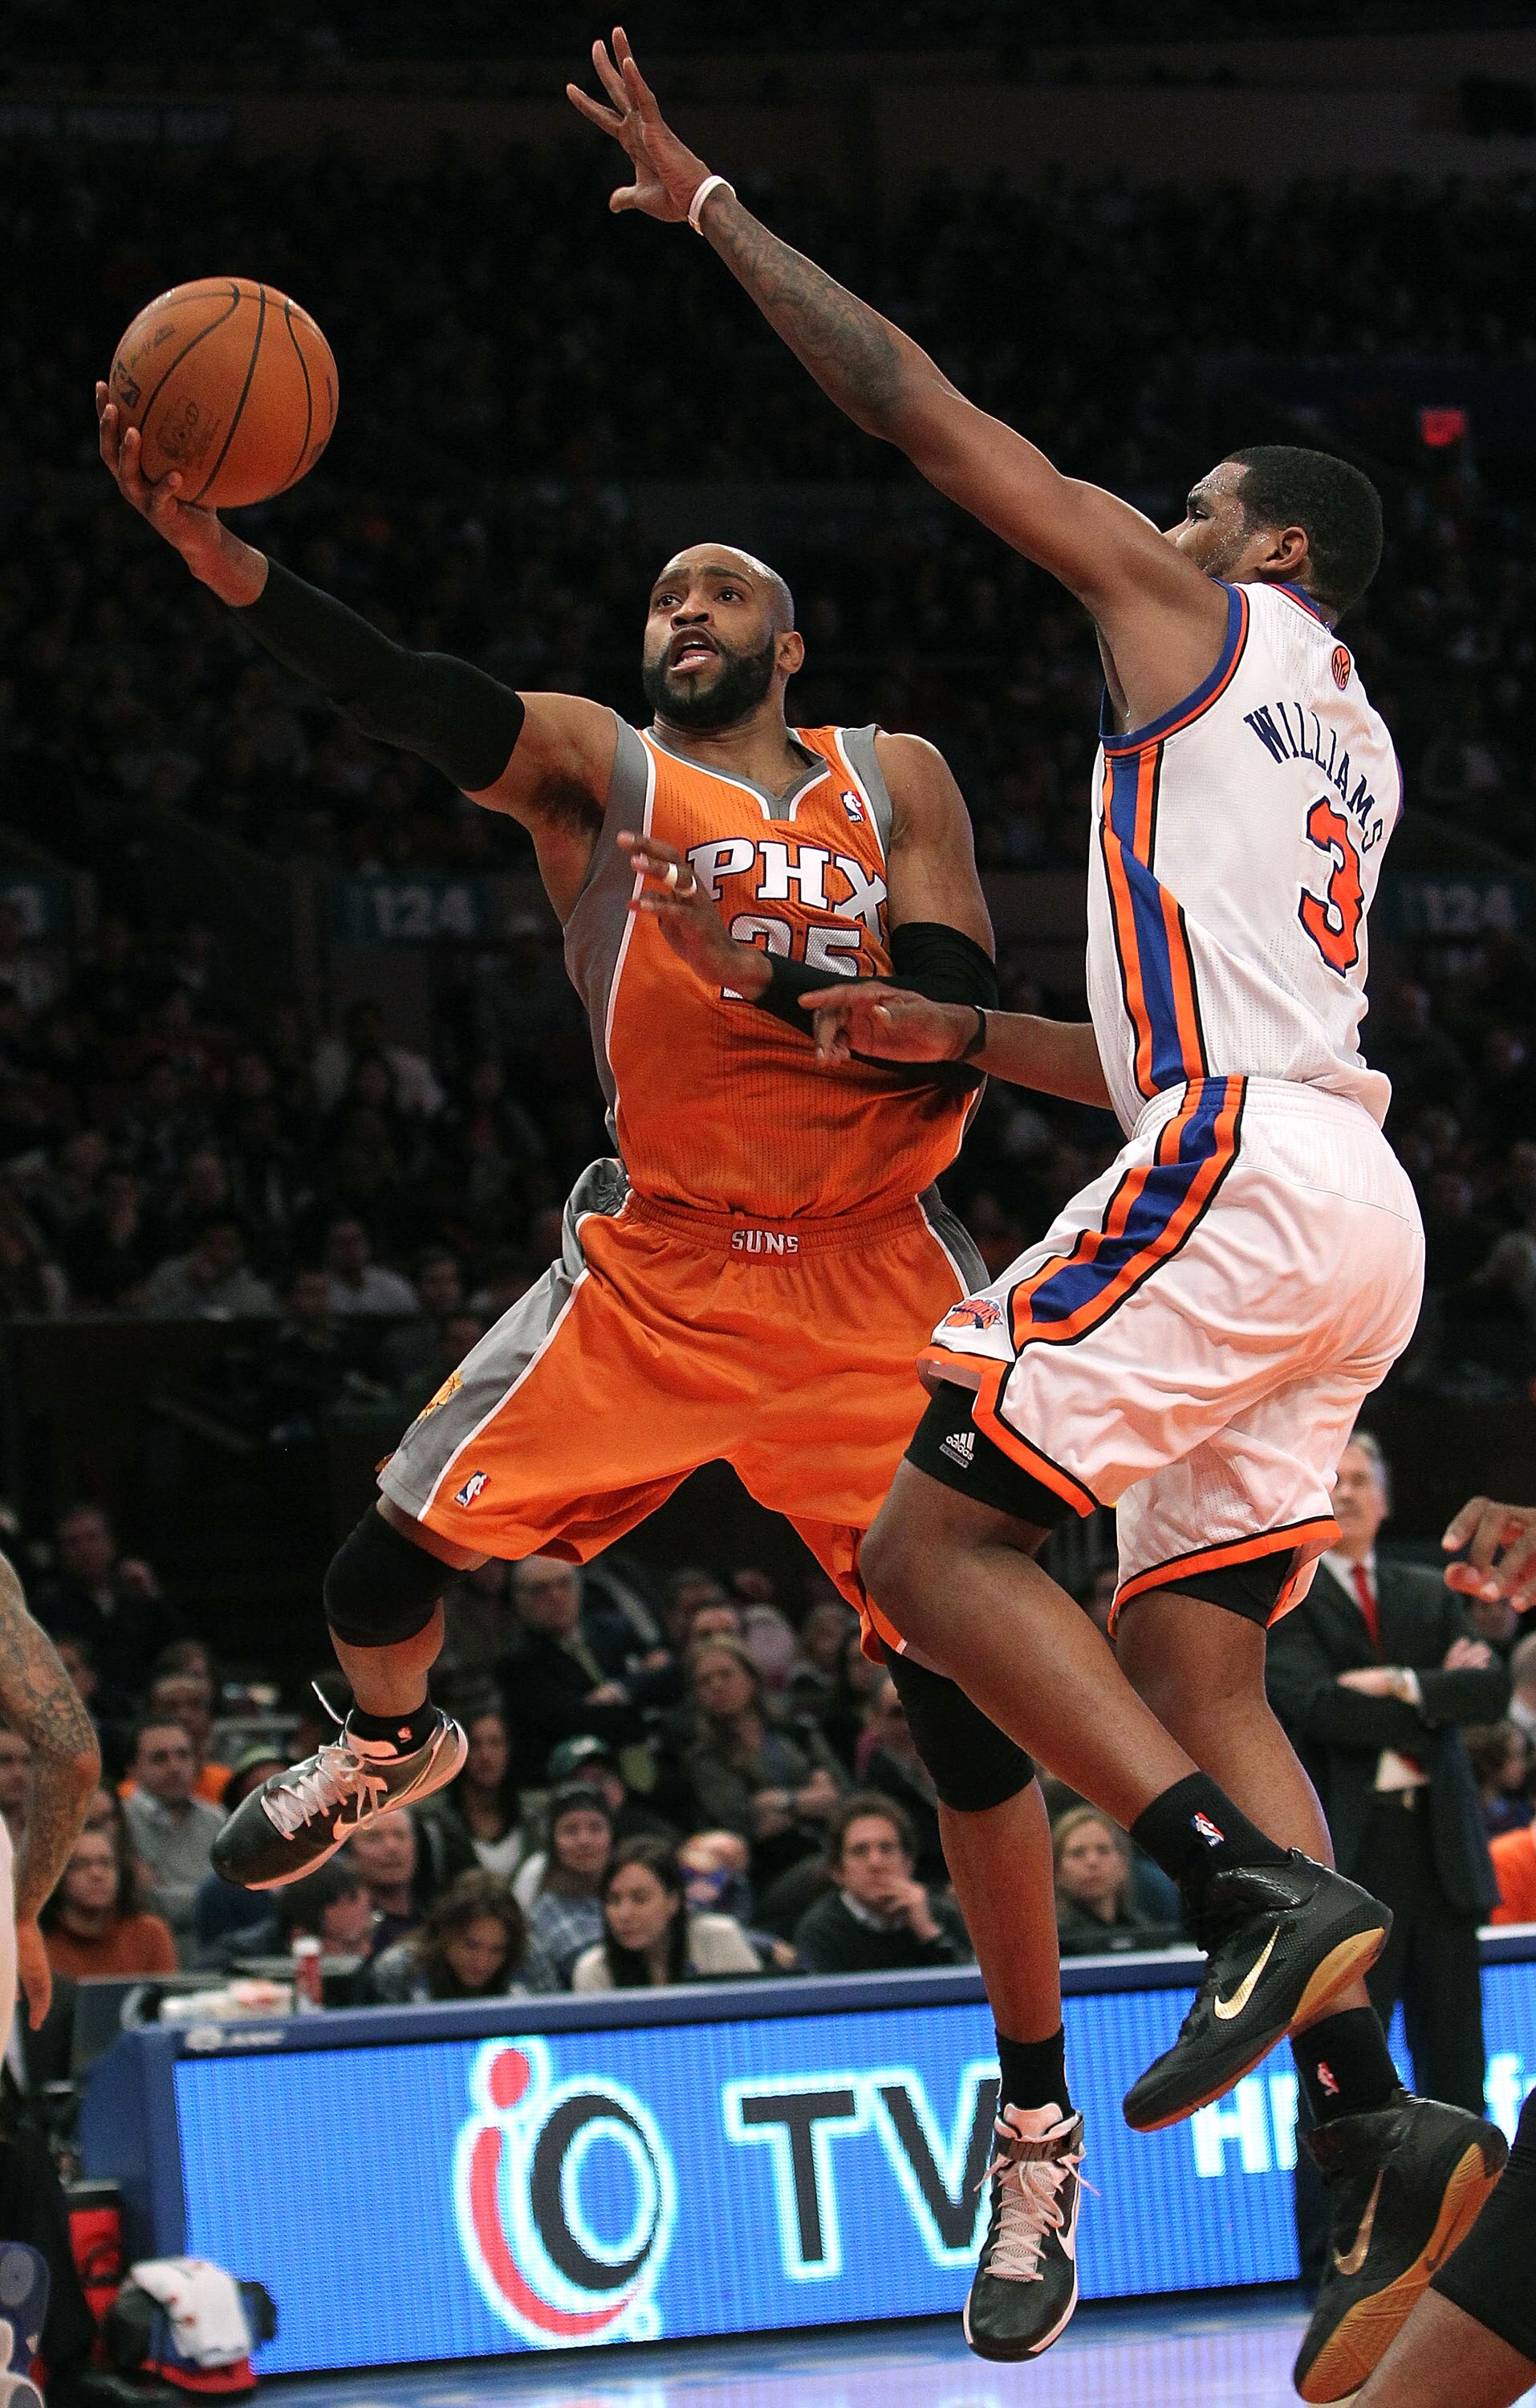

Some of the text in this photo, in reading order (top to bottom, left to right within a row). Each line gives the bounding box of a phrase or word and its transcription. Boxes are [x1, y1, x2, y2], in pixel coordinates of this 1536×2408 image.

[1243, 702, 1383, 853] WILLIAMS
[371, 886, 478, 938] 124
[686, 837, 888, 946] PHX
[1298, 795, 1364, 978] 3
[1424, 884, 1516, 935] 124
[731, 1230, 798, 1255] SUNS
[945, 1435, 974, 1461] adidas
[742, 2077, 1001, 2262] TV
